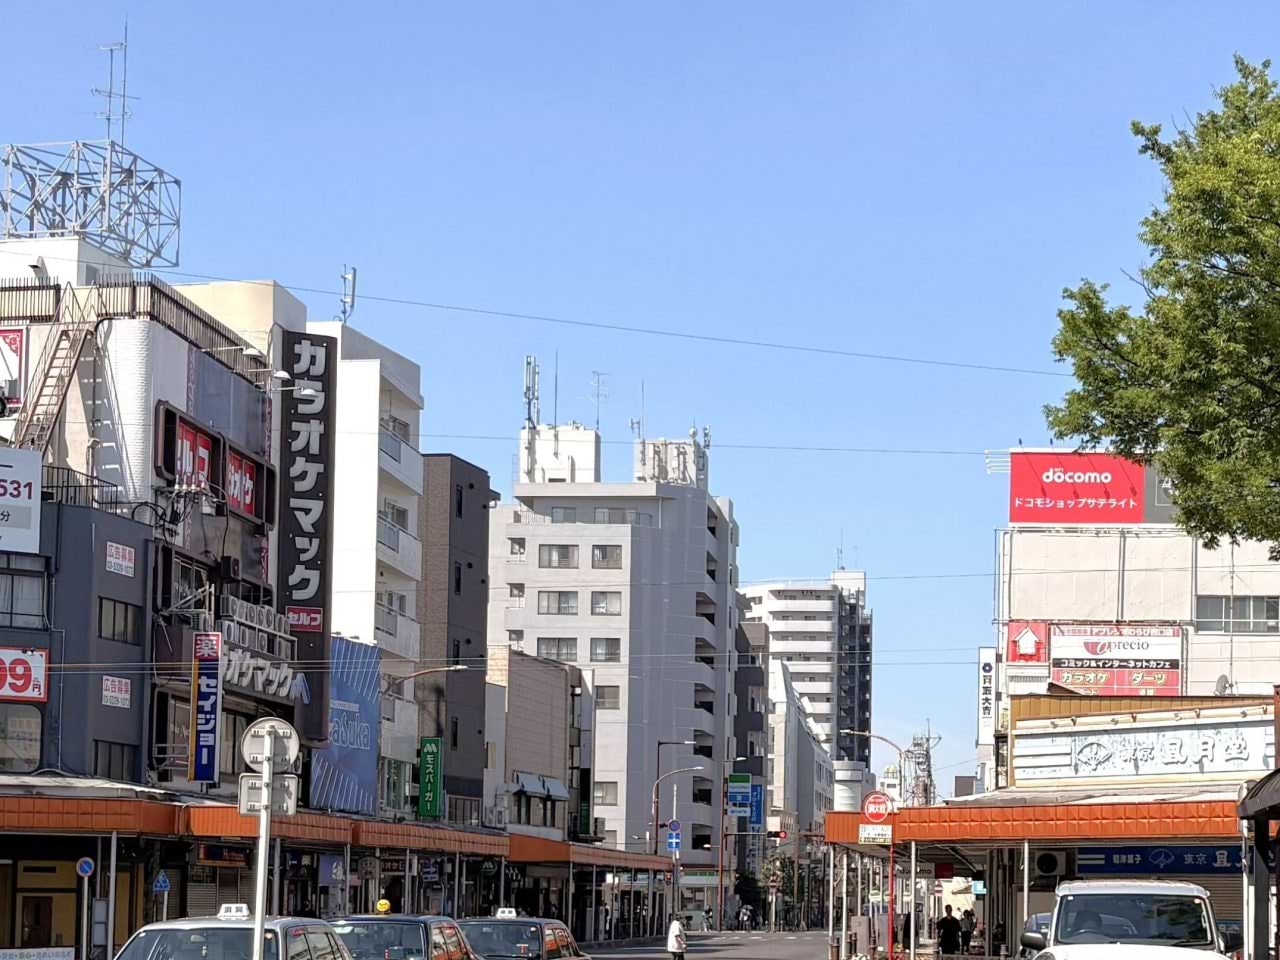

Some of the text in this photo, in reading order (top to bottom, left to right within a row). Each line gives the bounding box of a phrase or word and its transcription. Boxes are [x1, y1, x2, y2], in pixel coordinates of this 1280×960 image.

[288, 340, 326, 600] カラオケマック
[1042, 468, 1111, 483] docomo
[1015, 497, 1137, 508] ドコモショップサテライト
[287, 612, 321, 625] セルフ
[196, 635, 217, 657] 薬
[1062, 672, 1109, 684] カラオケ
[1131, 672, 1167, 685] ダーツ
[197, 676, 217, 765] セイジョー
[425, 755, 436, 810] モスバーガー
[900, 866, 932, 875] domo
